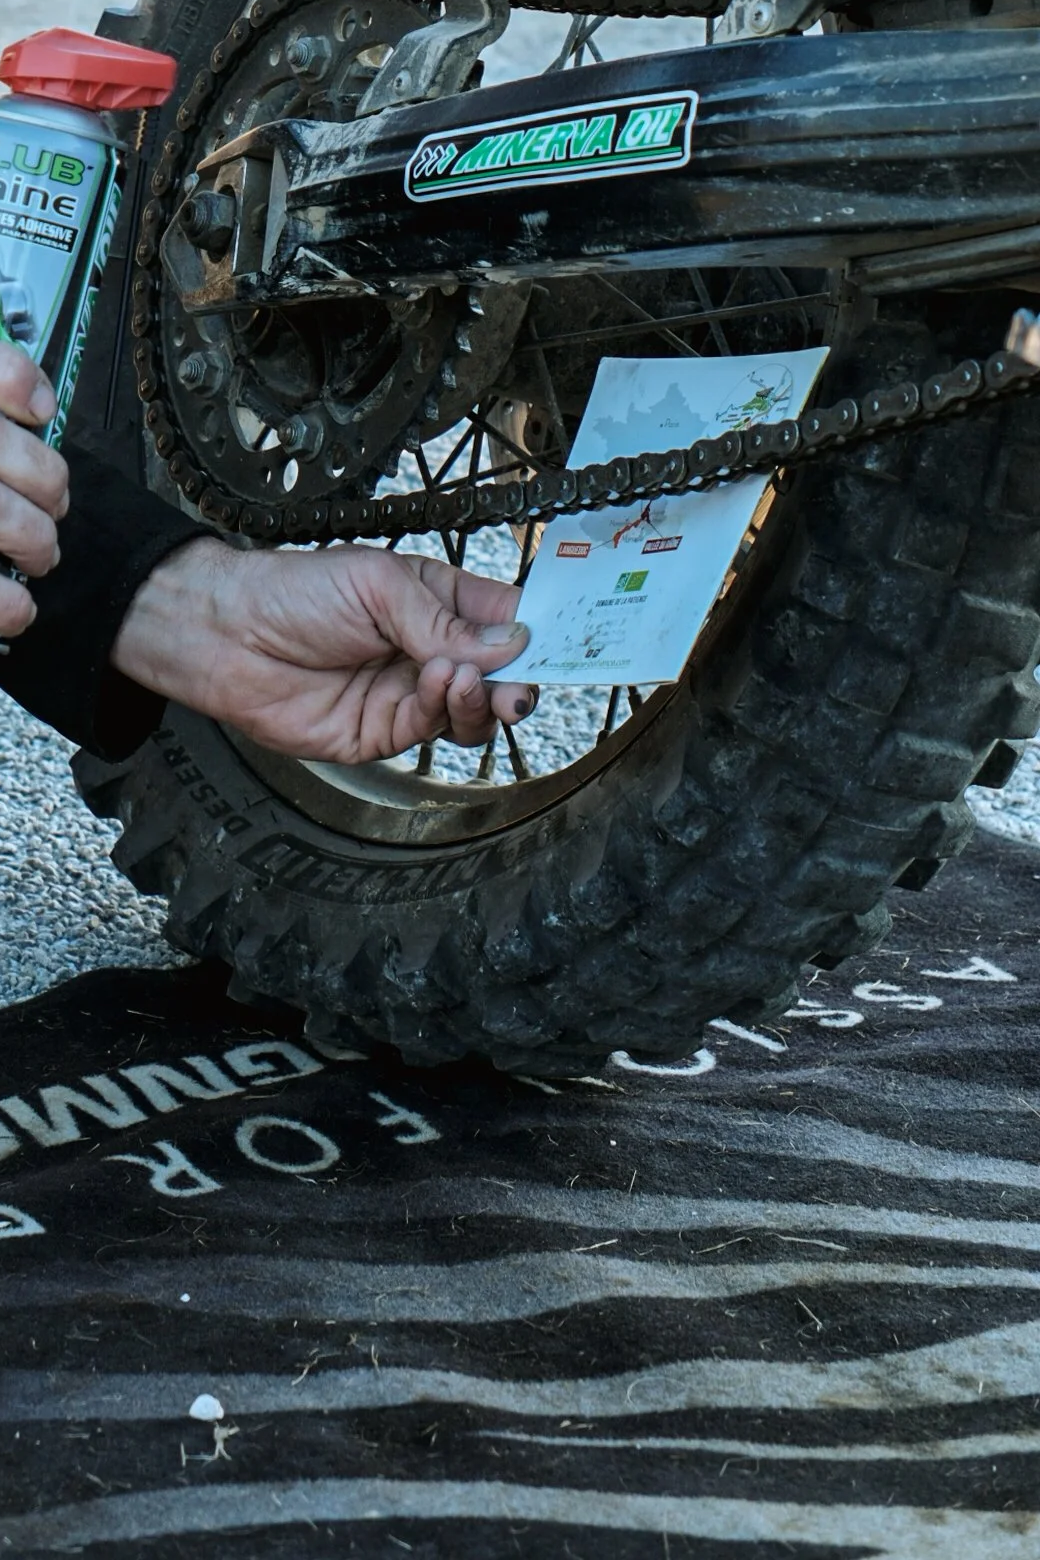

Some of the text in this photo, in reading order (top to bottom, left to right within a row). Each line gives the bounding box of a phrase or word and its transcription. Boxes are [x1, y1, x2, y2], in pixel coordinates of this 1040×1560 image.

[451, 108, 680, 176] MINERVA OIL
[16, 216, 74, 243] ADHESIVE
[102, 1091, 442, 1200] FOR
